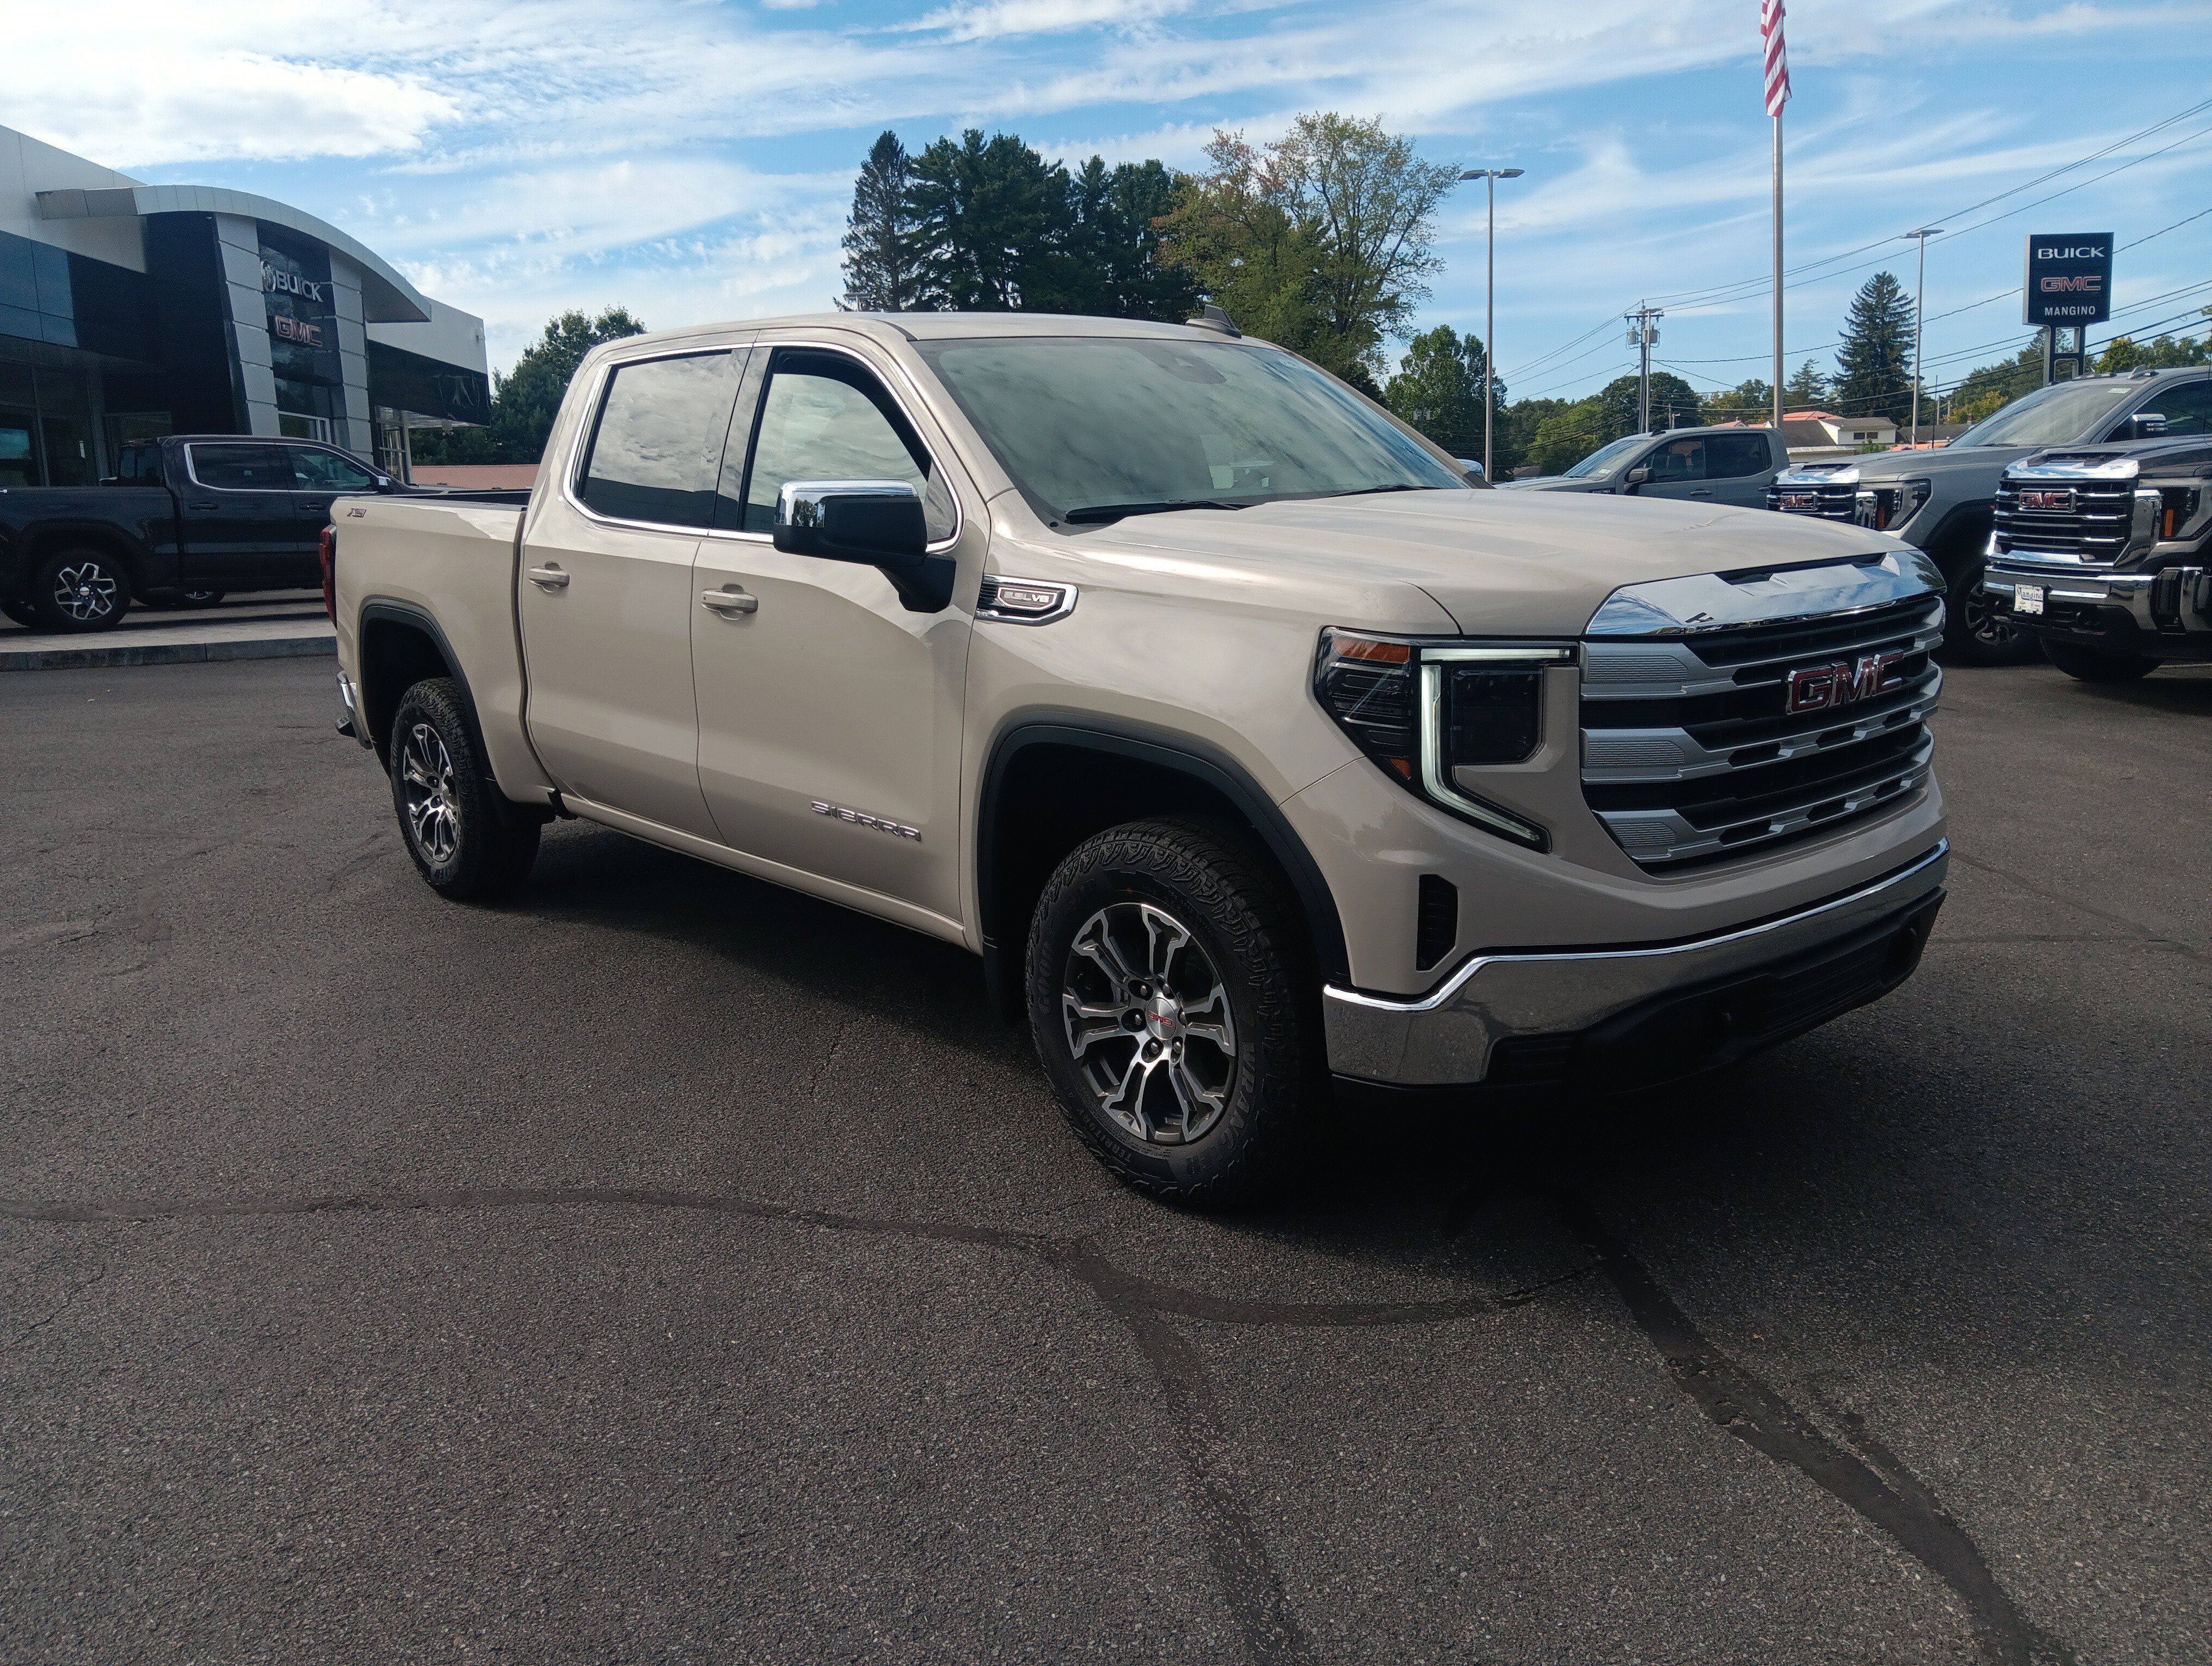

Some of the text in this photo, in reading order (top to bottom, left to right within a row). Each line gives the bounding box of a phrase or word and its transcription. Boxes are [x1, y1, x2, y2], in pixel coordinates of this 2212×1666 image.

[2038, 247, 2105, 259] BUICK
[275, 270, 324, 302] BUICK
[2041, 275, 2102, 292] GMC
[2044, 306, 2096, 316] MANGINO
[275, 315, 323, 347] GMC
[1780, 495, 1814, 508] GMC
[2020, 492, 2069, 509] GMC
[1032, 594, 1050, 603] V8
[1786, 649, 1904, 715] GMC
[812, 800, 921, 842] SIERRA
[1148, 1010, 1174, 1027] GMC
[1186, 1042, 1256, 1177] WRANGLER
[1076, 1107, 1133, 1163] TERRITORY
